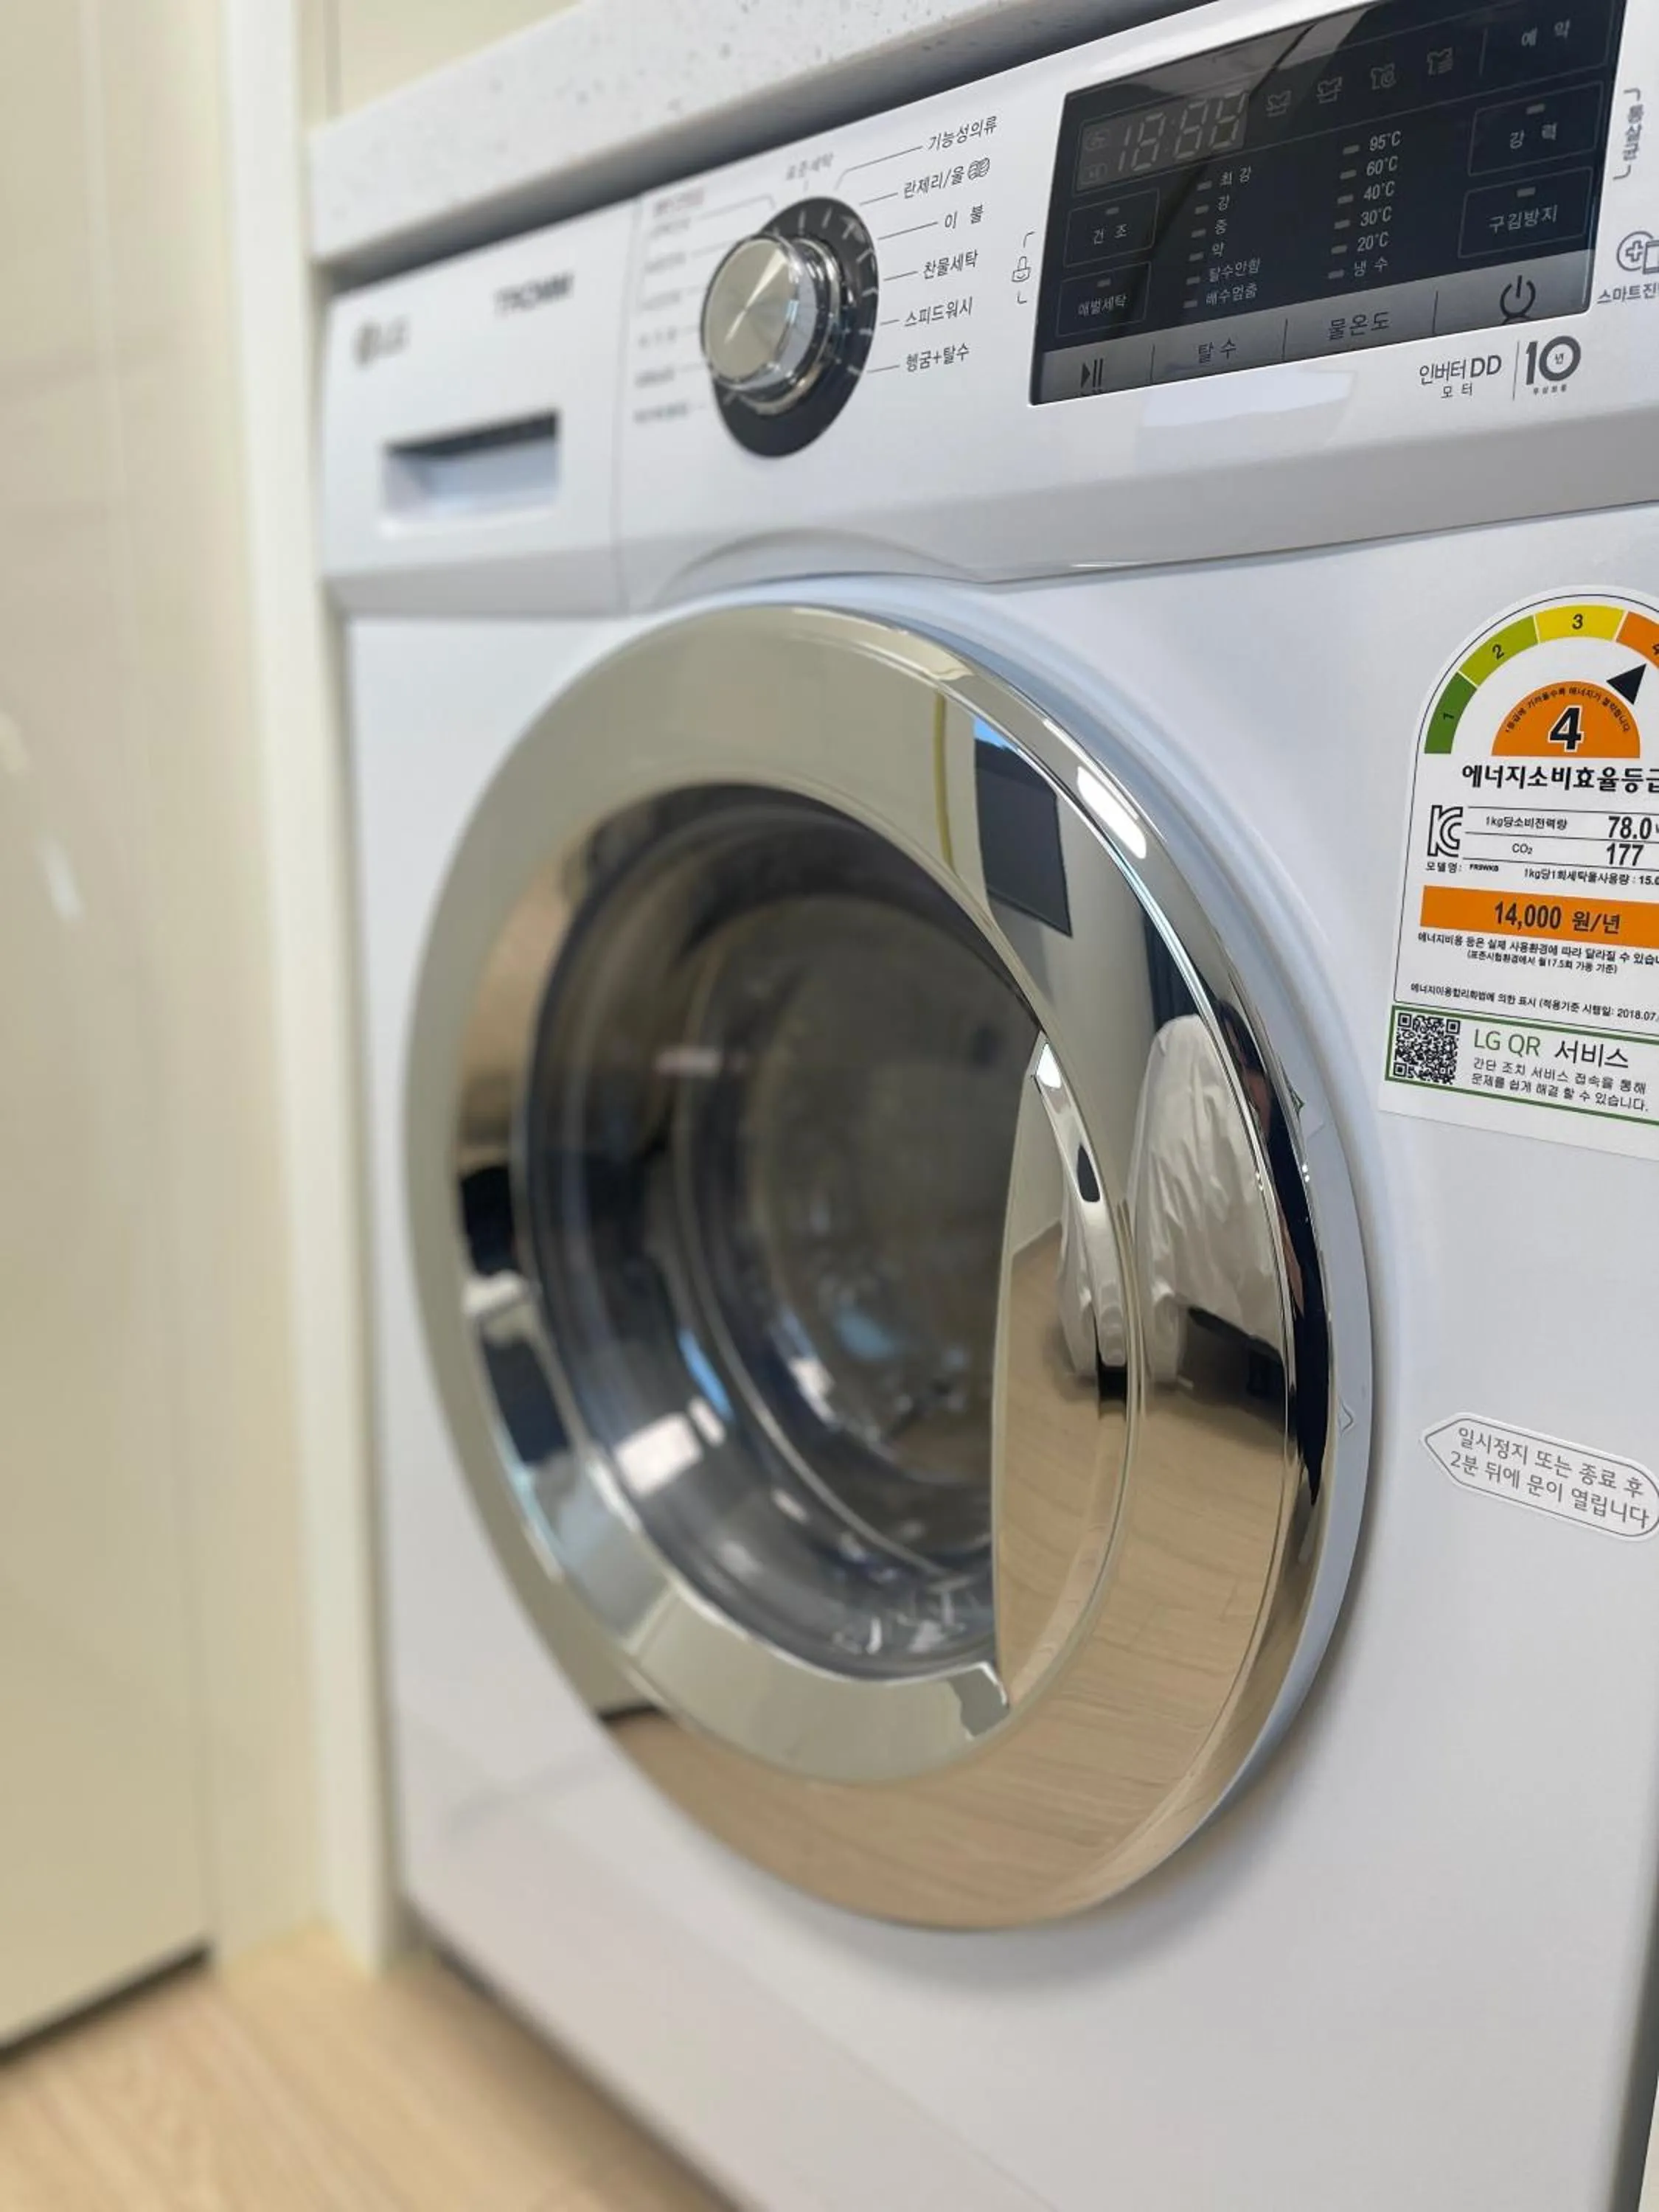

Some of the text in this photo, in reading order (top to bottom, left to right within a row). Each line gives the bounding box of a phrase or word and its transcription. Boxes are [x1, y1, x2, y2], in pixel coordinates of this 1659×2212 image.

[928, 116, 997, 150] 기능성의류
[1366, 156, 1398, 177] 60°C
[1363, 181, 1395, 201] 40°C
[1360, 206, 1392, 226] 30°C
[1489, 205, 1557, 234] 구김방지
[1357, 231, 1389, 251] 20°C
[923, 249, 978, 279] 찬물세탁
[1597, 282, 1659, 305] 스마트진
[904, 296, 973, 327] 스피드워시
[1572, 613, 1584, 630] 3
[1492, 644, 1506, 660] 2
[1442, 712, 1455, 721] 1
[1548, 706, 1583, 751] 4
[1607, 815, 1652, 839] 78.0
[1606, 843, 1644, 866] 177
[1495, 901, 1621, 935] 14,000 원/년
[1418, 931, 1463, 947] 에너지비용
[1488, 939, 1506, 950] 실제
[1509, 941, 1558, 956] 사용환경에
[1561, 946, 1582, 959] 따라
[1619, 953, 1630, 963] 수
[1498, 993, 1516, 1005] 의한
[1518, 996, 1537, 1008] 표시
[1617, 1008, 1659, 1022] 2018.07.
[1474, 1029, 1629, 1068] LG QR 서비스
[1474, 1057, 1646, 1095] 간단 조치 서비스 접속을 통해
[1472, 1073, 1649, 1112] 문제를 쉽게 해결 할 수 있습니다.
[1458, 1427, 1644, 1498] 일시정지 또는 종료 후
[1450, 1450, 1649, 1529] 2분 뒤에 문이 열립니다
